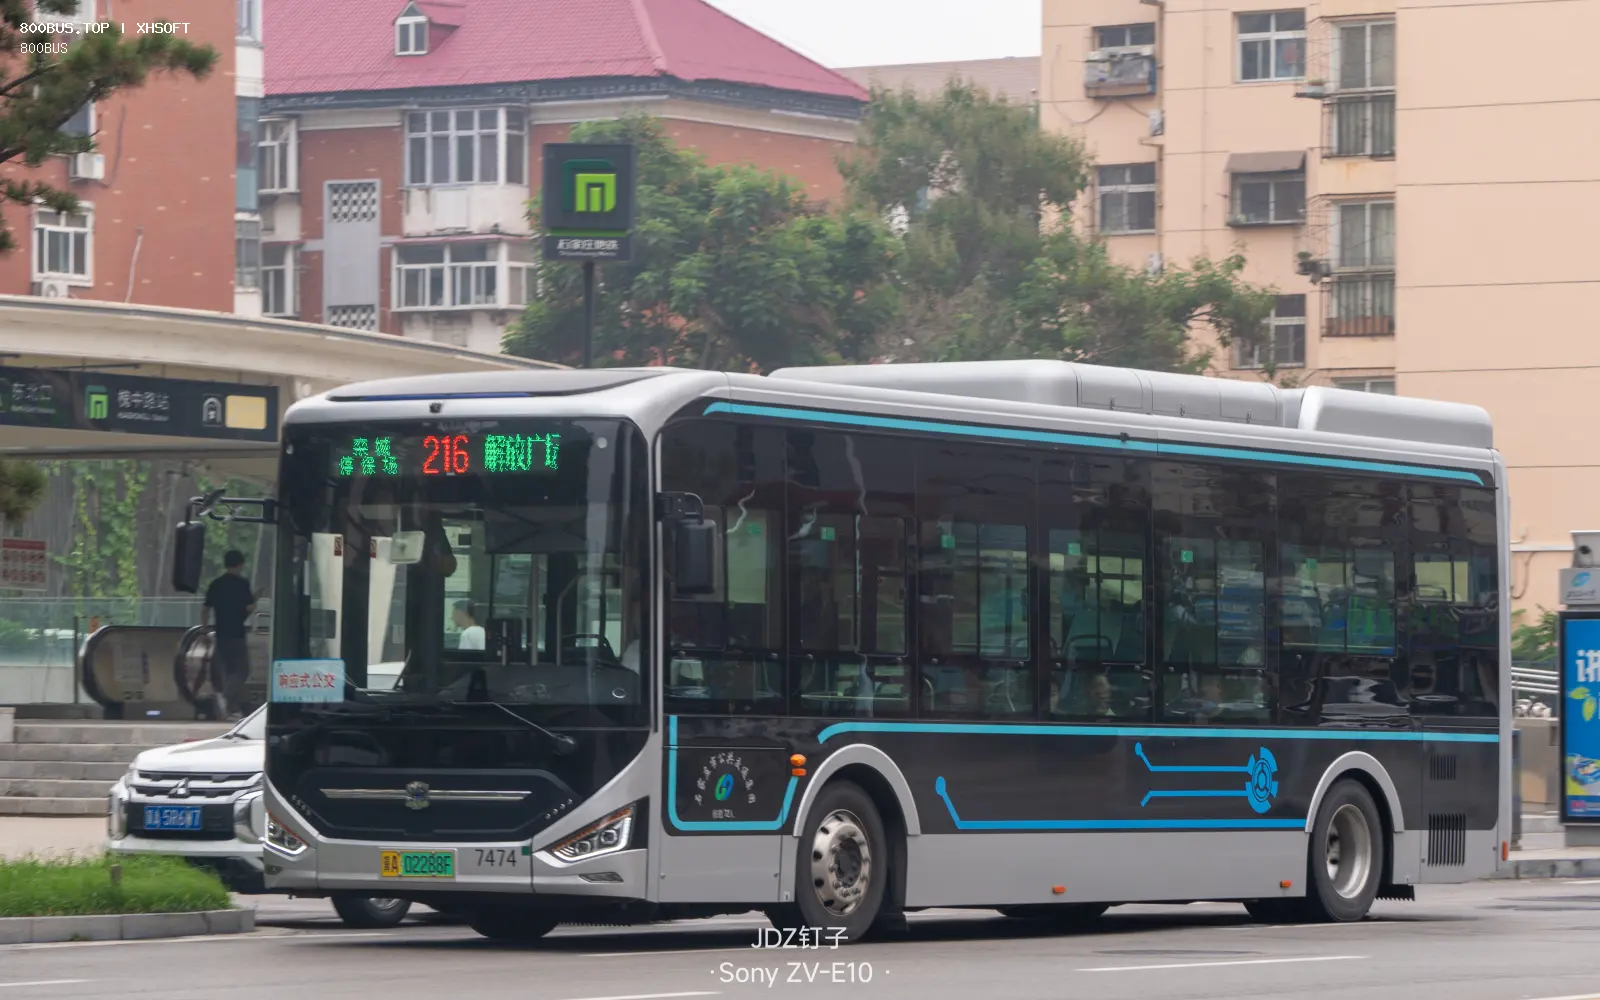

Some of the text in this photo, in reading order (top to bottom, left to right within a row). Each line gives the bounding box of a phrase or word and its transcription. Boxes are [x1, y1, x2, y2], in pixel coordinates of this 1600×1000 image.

[422, 434, 469, 474] 216
[279, 671, 336, 689] 响应式公交
[475, 849, 517, 867] 7474
